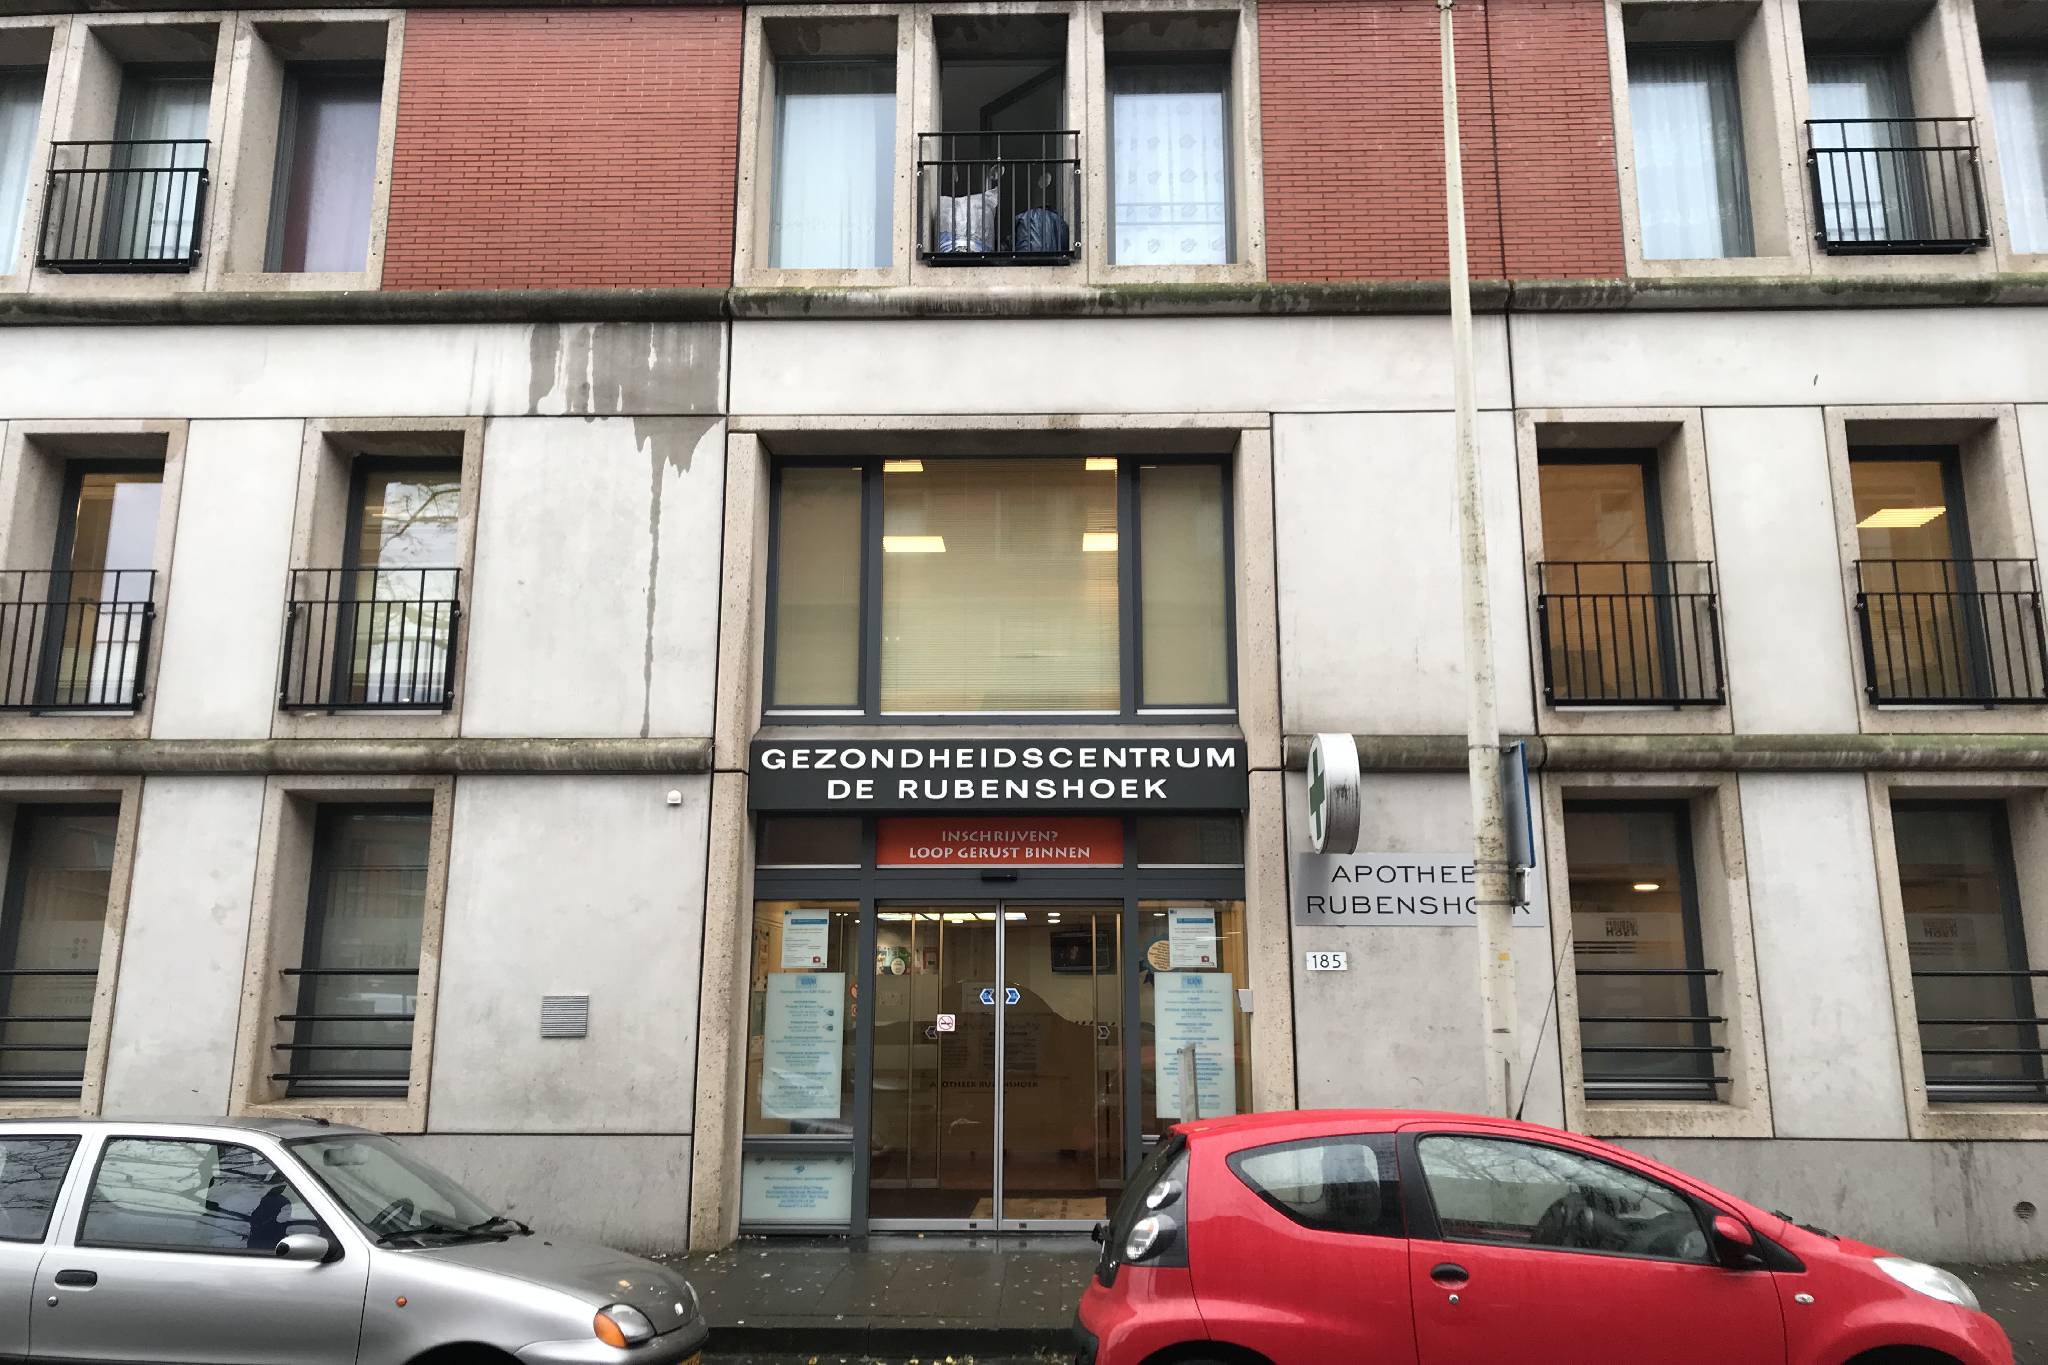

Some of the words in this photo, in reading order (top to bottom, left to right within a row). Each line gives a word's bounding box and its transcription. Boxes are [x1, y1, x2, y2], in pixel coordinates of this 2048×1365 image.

[761, 747, 1236, 770] GEZONDHEIDSCENTRUM
[827, 778, 874, 800] DE
[898, 778, 1168, 800] RUBENSHOEK
[942, 830, 1058, 842] INSCHRIJVEN?
[909, 846, 953, 859] LOOP
[957, 846, 1019, 859] GERUST
[1024, 846, 1091, 859] BINNEN
[1331, 865, 1476, 883] APOTHEE
[1307, 896, 1530, 915] RUBENSHOK
[1311, 954, 1342, 969] 185
